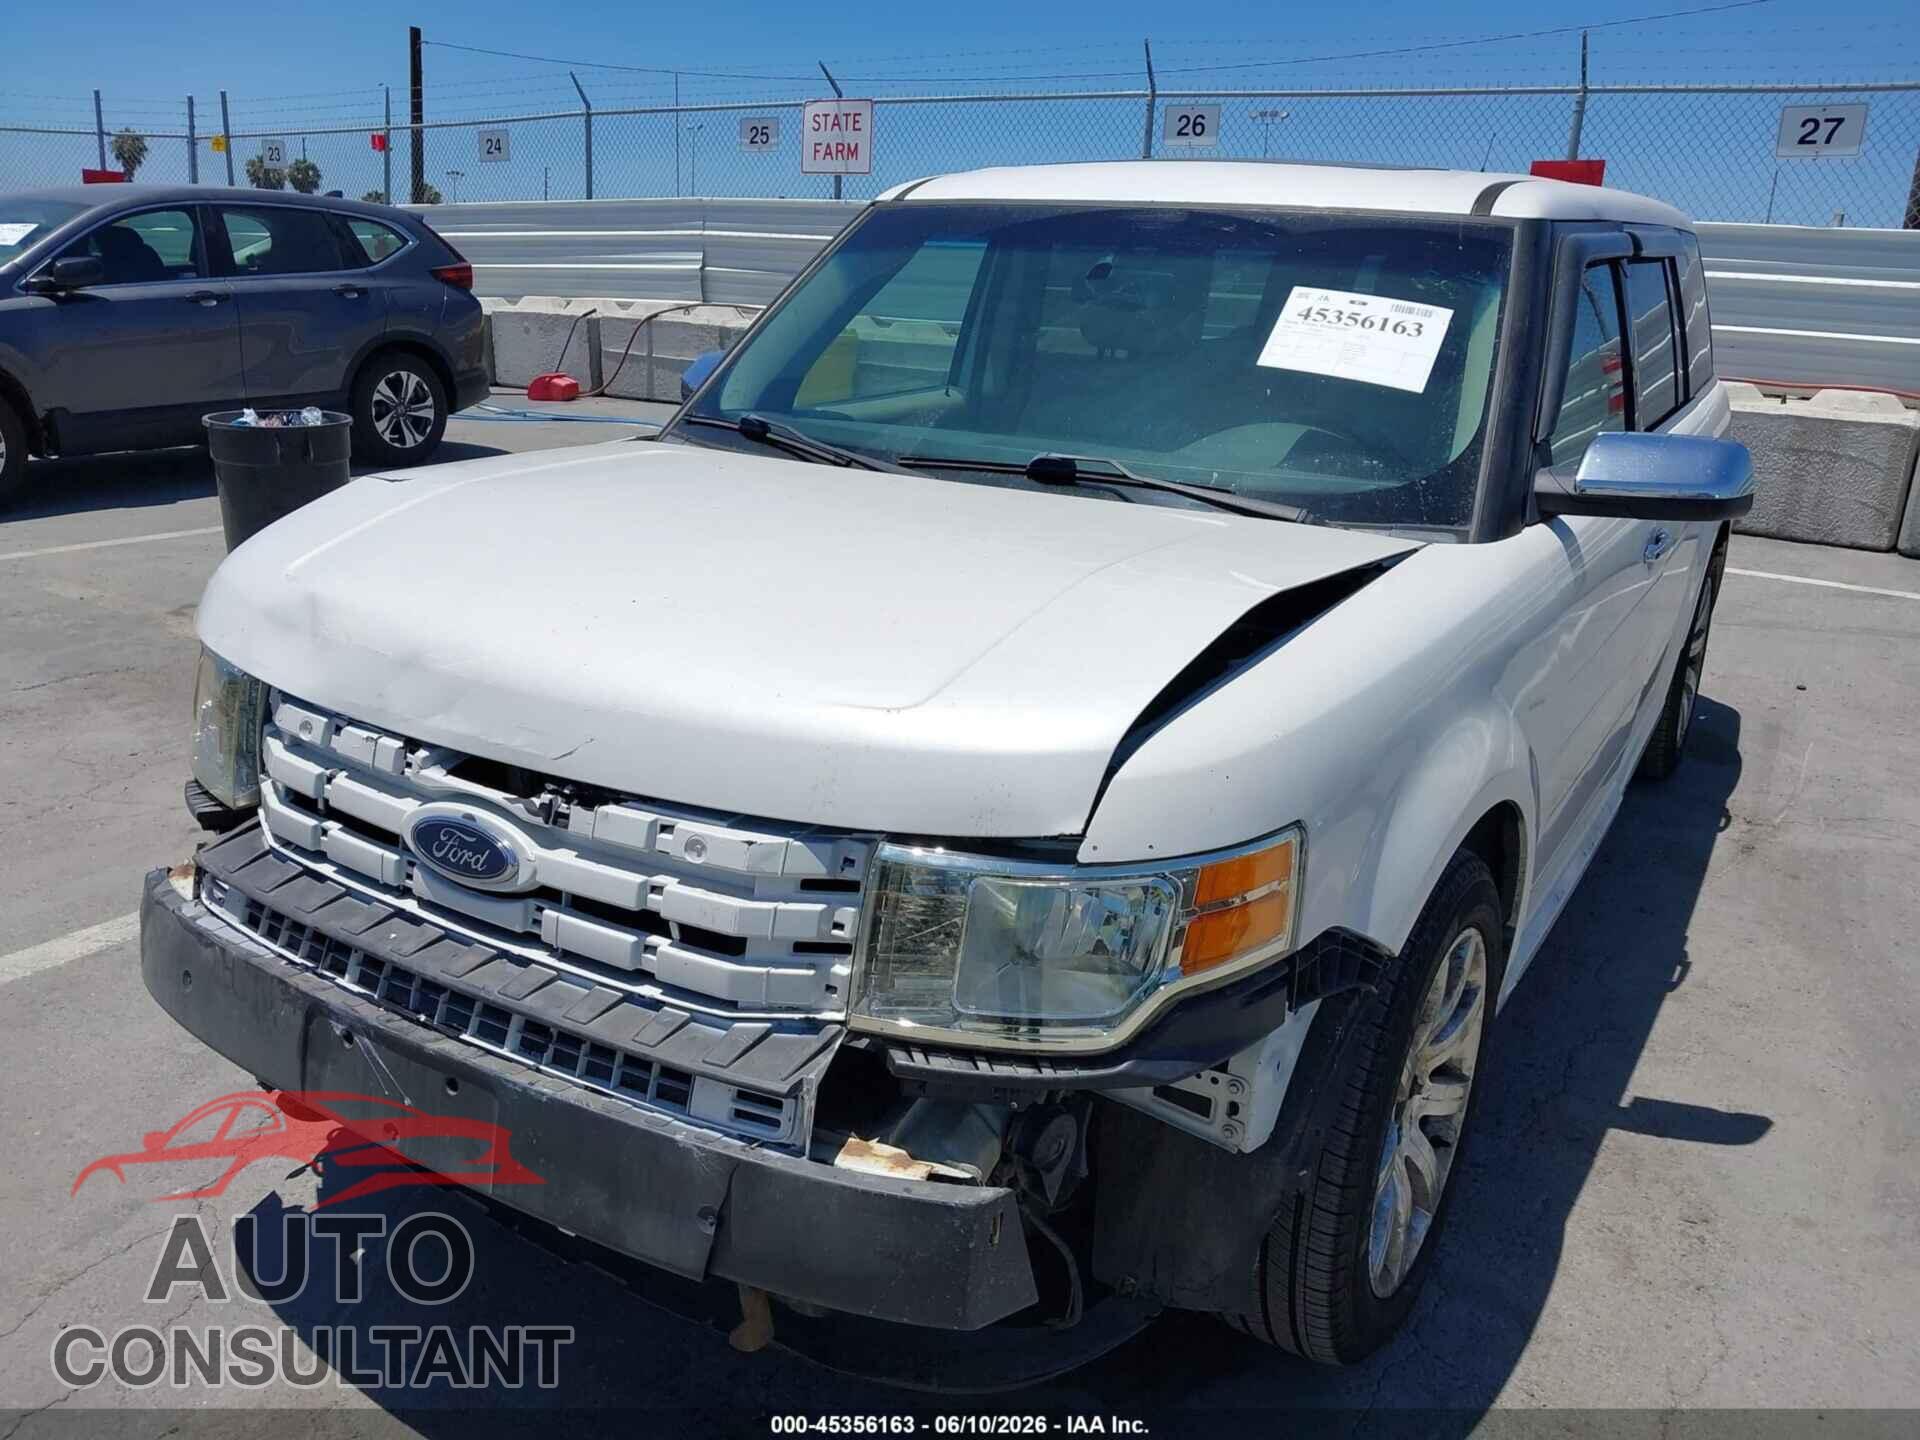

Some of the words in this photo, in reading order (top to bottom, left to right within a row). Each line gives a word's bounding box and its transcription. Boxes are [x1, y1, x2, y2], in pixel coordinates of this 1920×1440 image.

[811, 112, 863, 132] STATE
[1176, 114, 1206, 137] 26
[1797, 117, 1846, 145] 27
[749, 125, 770, 145] 25
[268, 146, 281, 162] 23
[486, 138, 502, 155] 24
[813, 142, 859, 160] FARM
[1297, 306, 1423, 337] 45356163
[432, 827, 491, 871] Ford
